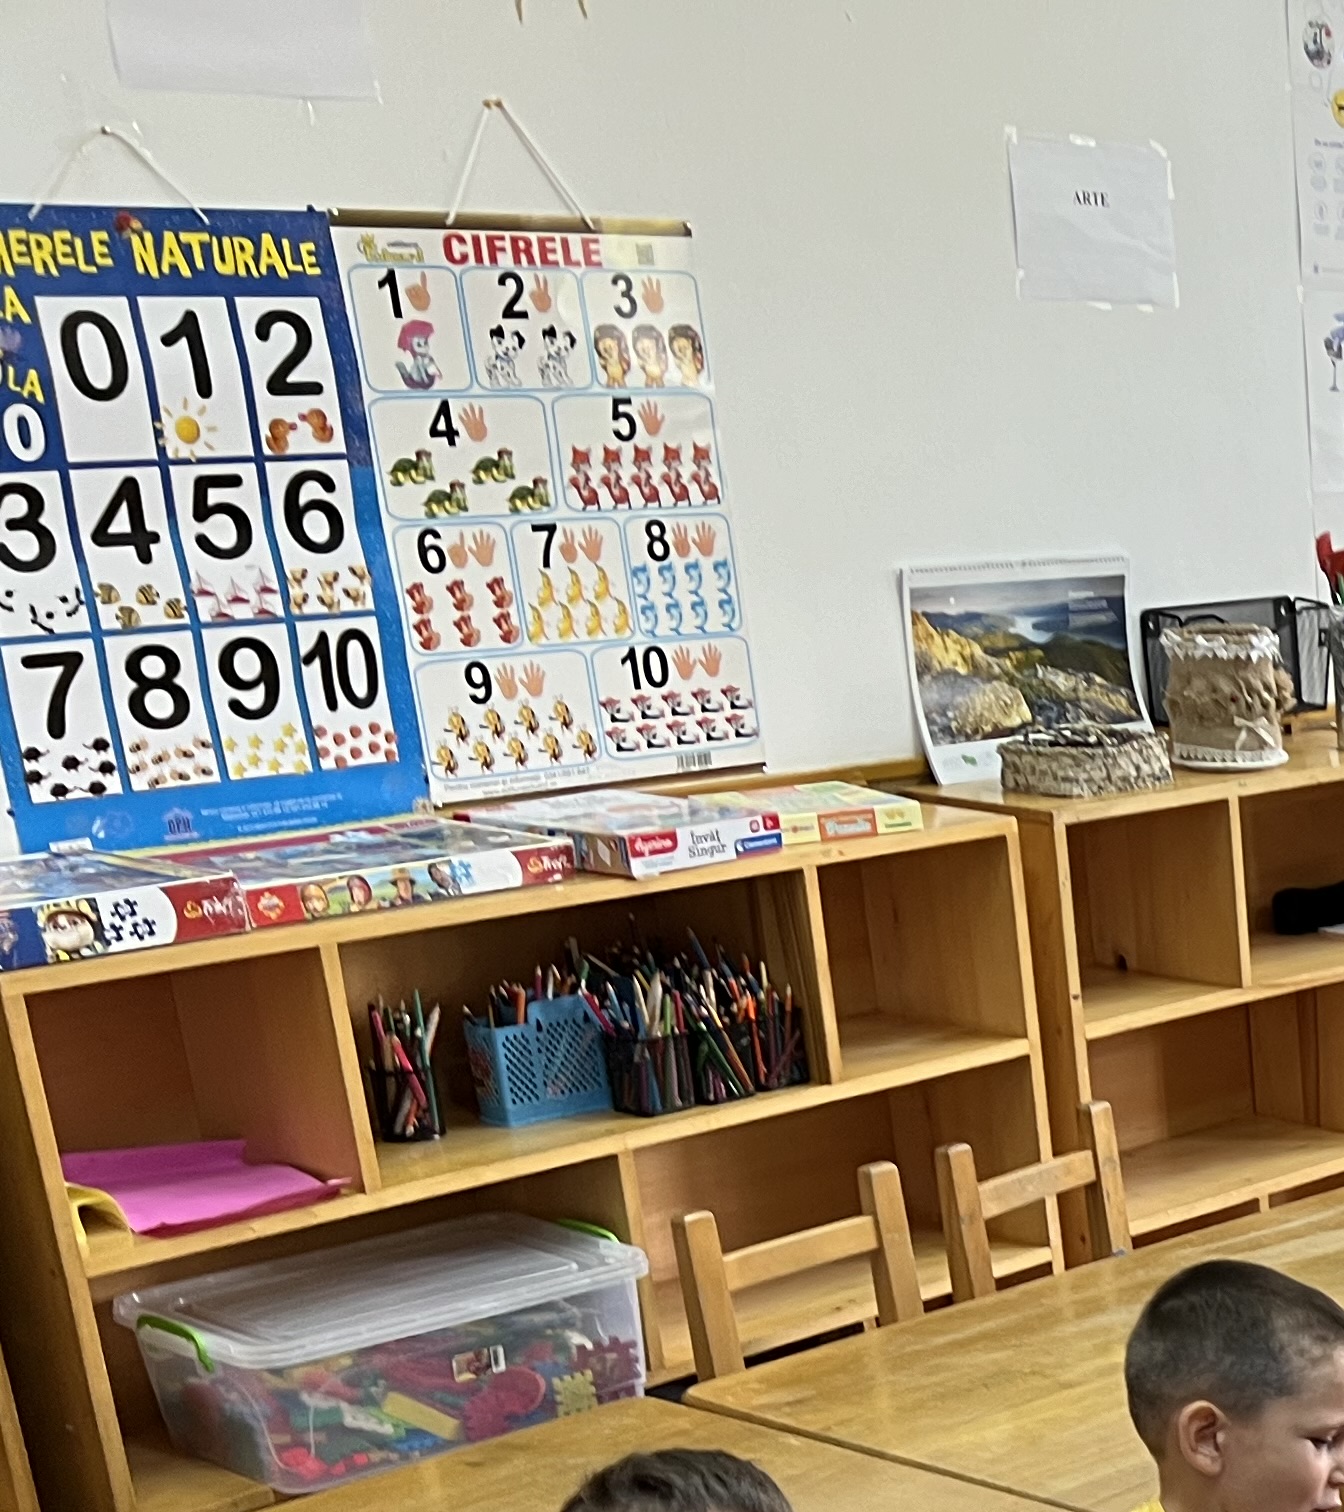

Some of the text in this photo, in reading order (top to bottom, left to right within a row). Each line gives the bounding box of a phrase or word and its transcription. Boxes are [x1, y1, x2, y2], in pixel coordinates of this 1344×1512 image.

[1073, 190, 1110, 208] ARTE
[131, 231, 322, 280] NATURALE
[443, 231, 602, 267] CIFRELE
[378, 268, 638, 319] 1 2 3
[60, 309, 324, 401] 0 1 2
[429, 397, 637, 447] 4 5
[0, 469, 344, 572] 3 4 5 6
[417, 519, 671, 574] 6 7 8
[21, 628, 379, 740] 7 8 9 10
[464, 646, 669, 704] 9 10
